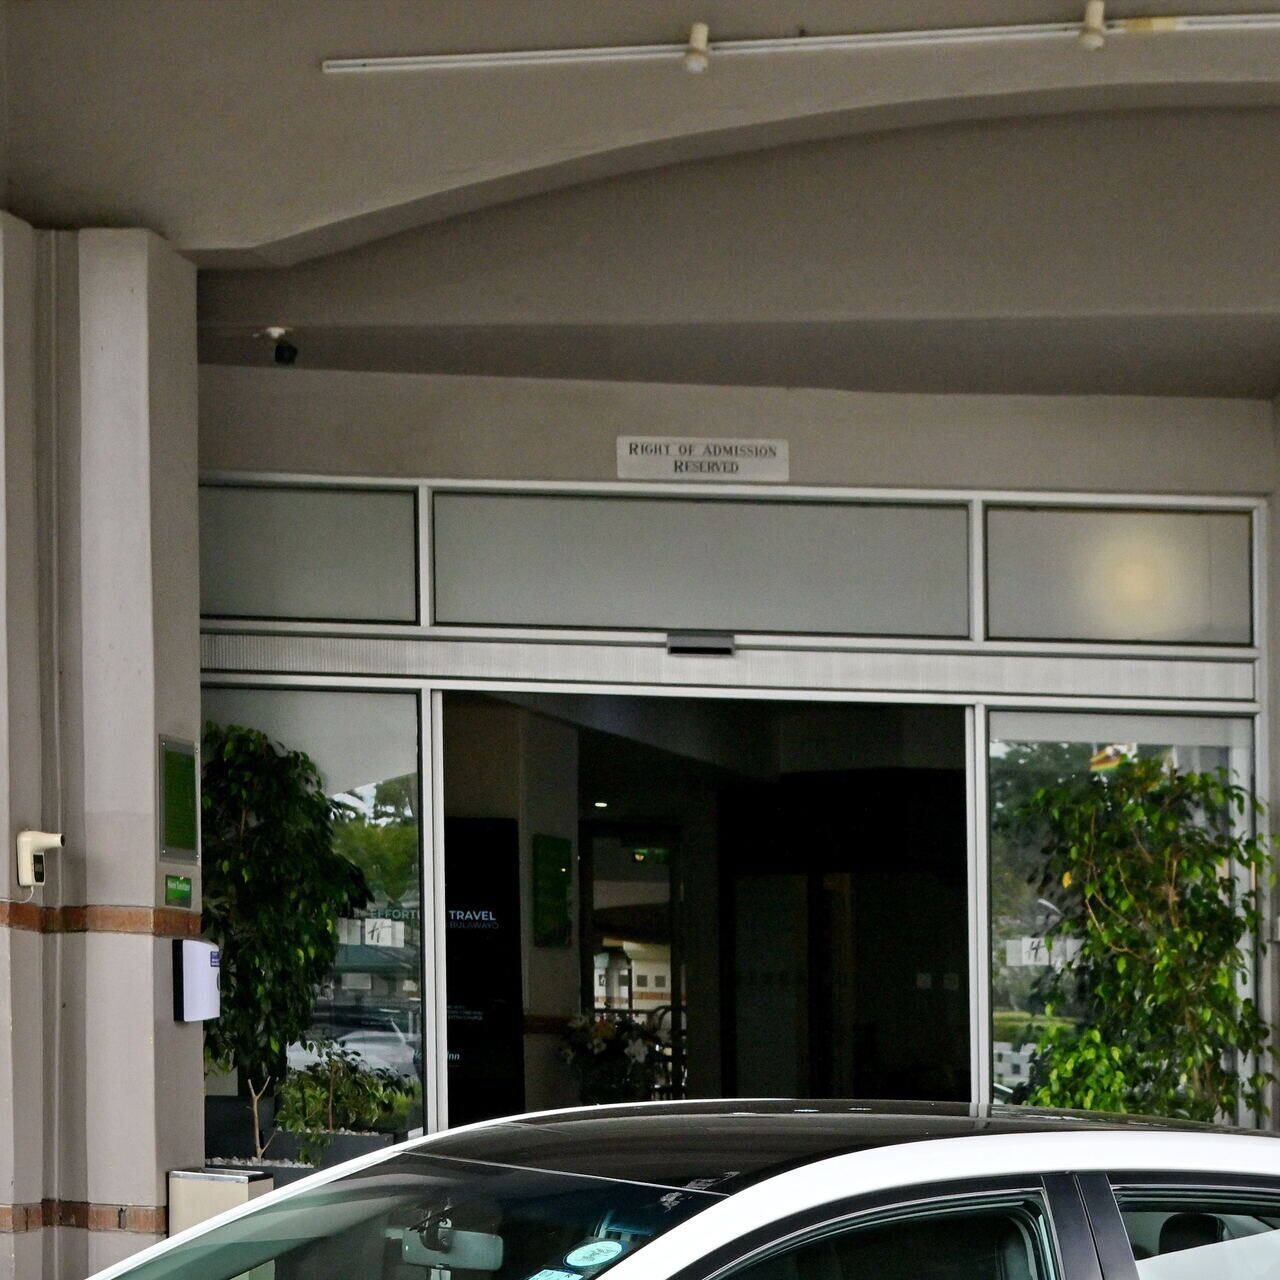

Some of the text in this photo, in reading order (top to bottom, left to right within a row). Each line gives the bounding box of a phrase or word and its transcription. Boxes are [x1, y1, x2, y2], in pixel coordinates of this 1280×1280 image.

[628, 442, 777, 457] RIGHT OF ADMISSION
[673, 460, 739, 473] RESERVED
[370, 909, 497, 921] EFFORT TRAVEL
